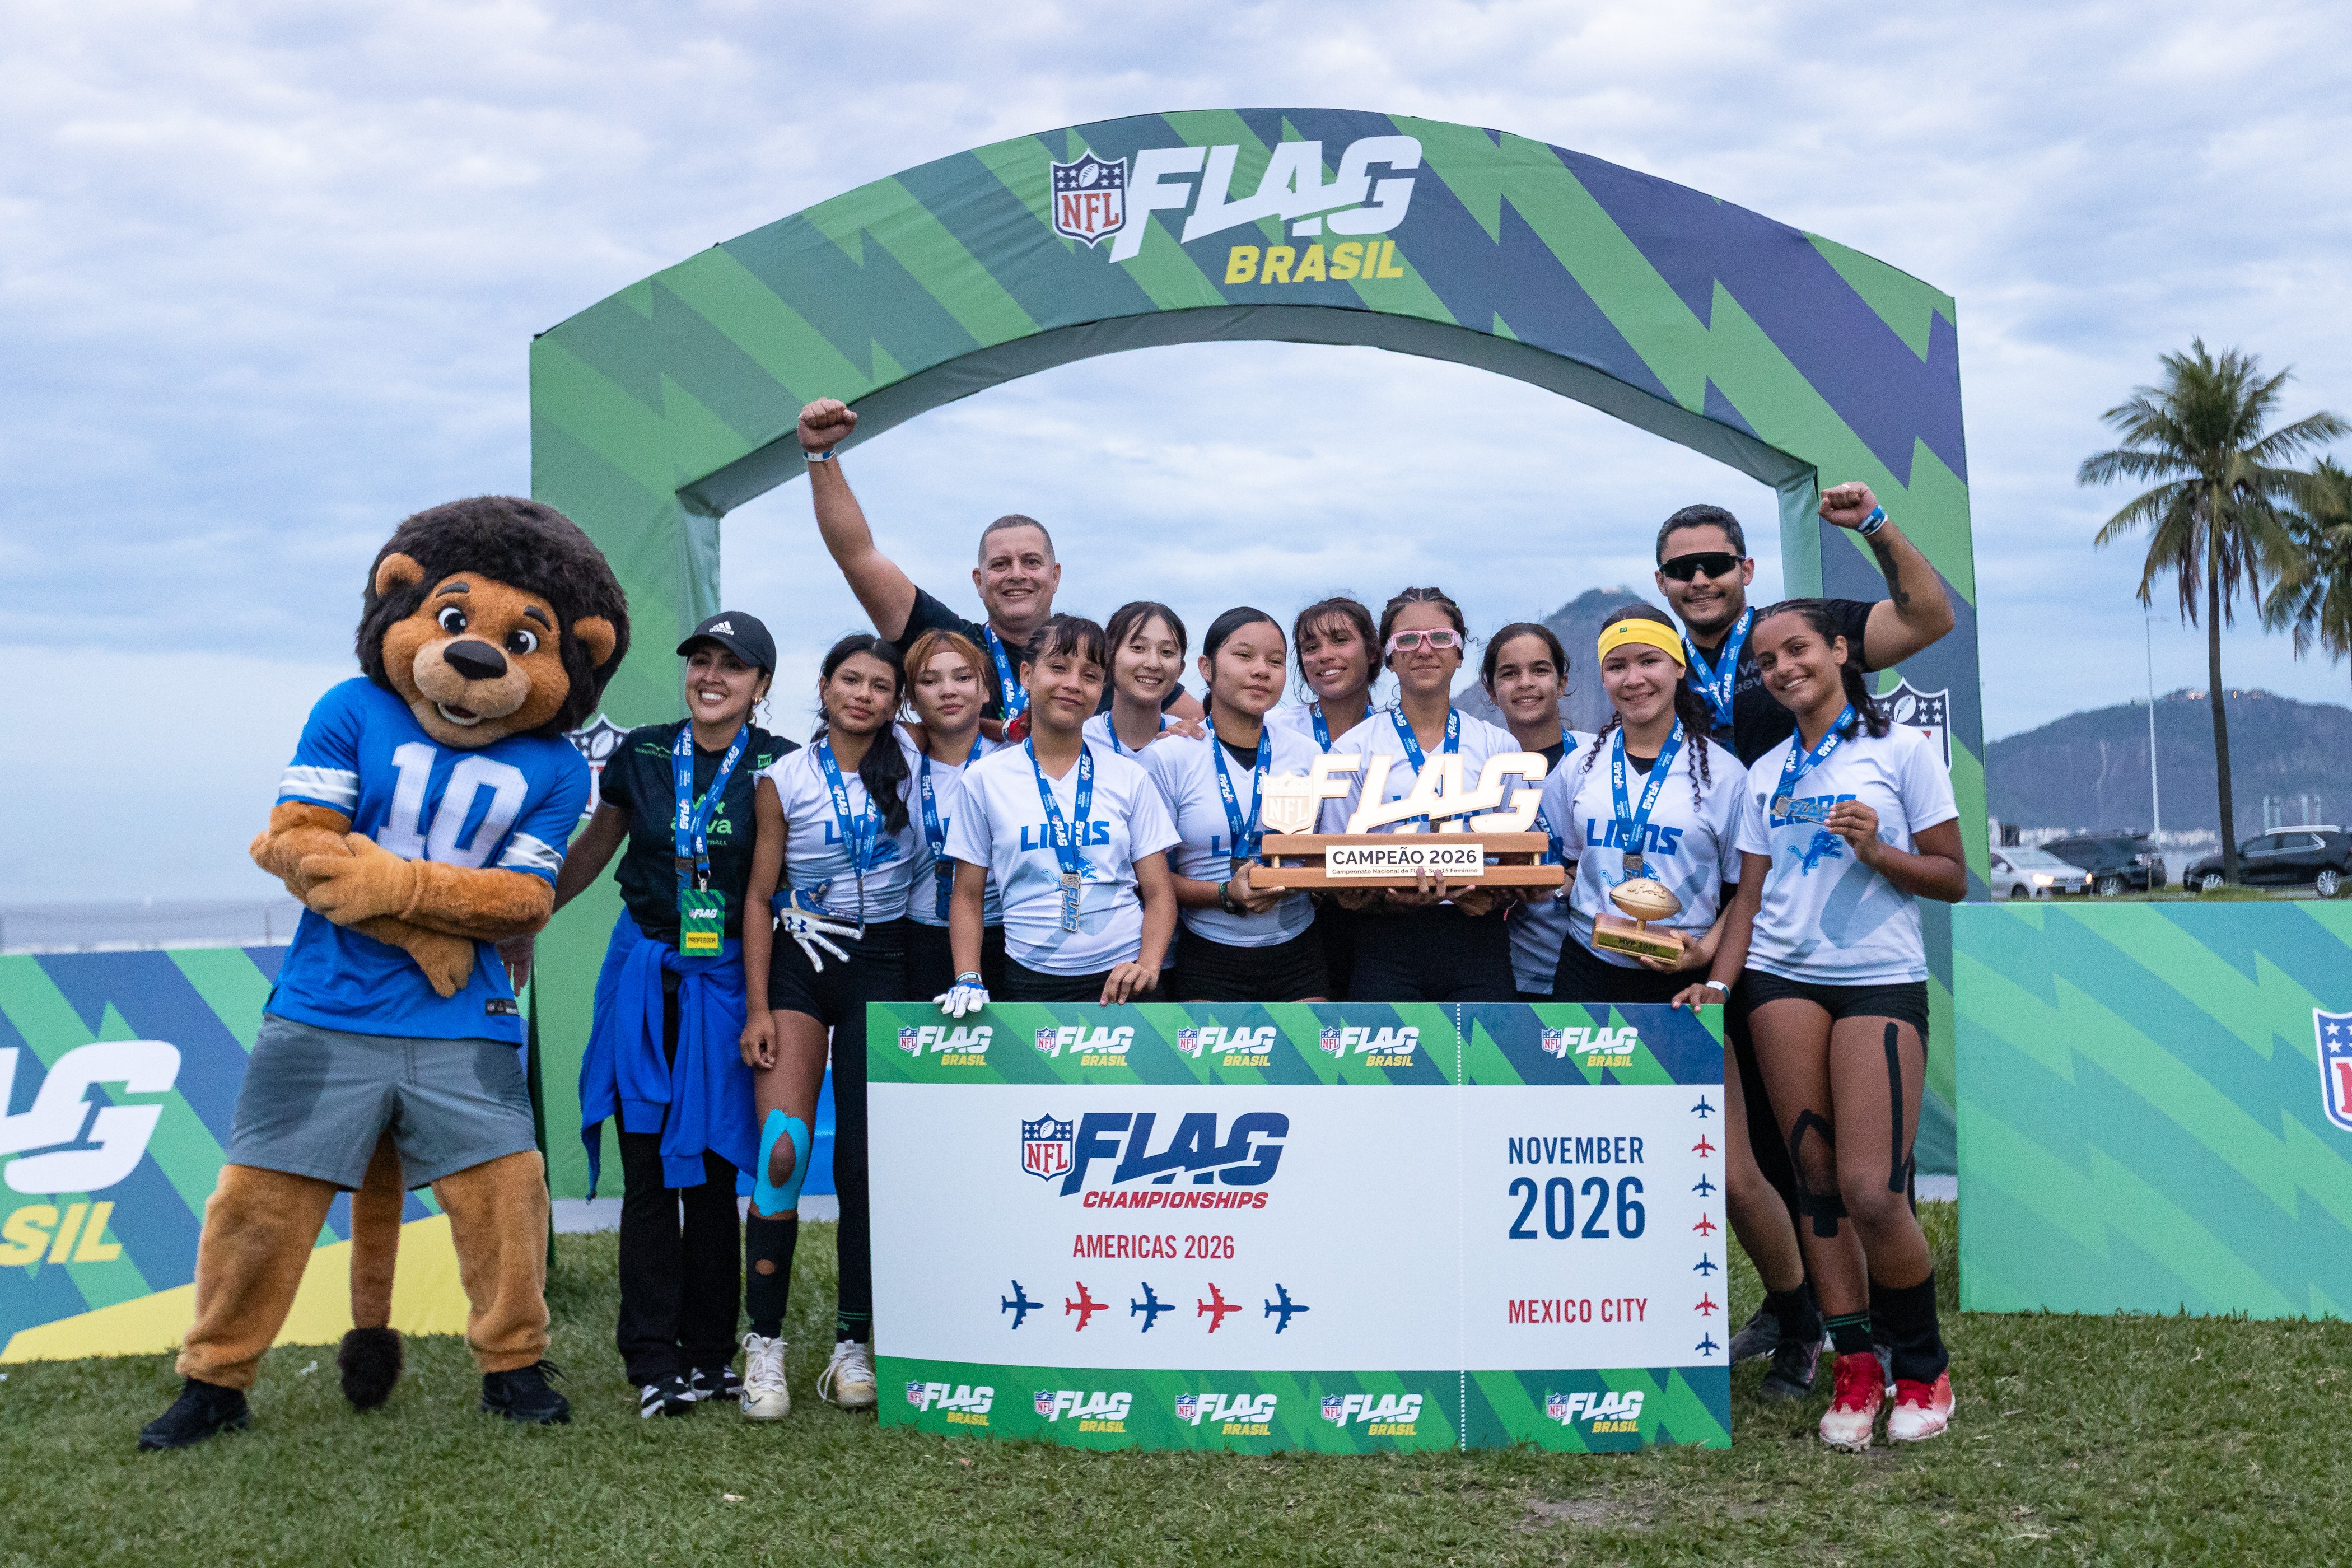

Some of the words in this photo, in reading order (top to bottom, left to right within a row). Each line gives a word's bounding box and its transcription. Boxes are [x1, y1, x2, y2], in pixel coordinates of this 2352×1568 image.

[1061, 192, 1120, 234] NFL
[1109, 136, 1423, 263] FLAG
[1224, 240, 1404, 285] BRASIL
[709, 627, 734, 636] adidas
[377, 741, 528, 869] 10
[1267, 796, 1309, 826] NFL
[1297, 752, 1548, 834] FLAG
[1642, 783, 1659, 810] FLAG
[1052, 820, 1068, 847] FLAG
[1332, 846, 1424, 865] CAMPEÃO
[1429, 850, 1477, 864] 2026
[693, 909, 717, 919] FLAG
[1061, 883, 1080, 932] FLAG
[899, 1037, 917, 1049] NFL
[912, 1026, 993, 1058] FLAG
[1037, 1038, 1056, 1049] NFL
[1049, 1026, 1135, 1058] FLAG
[1179, 1038, 1197, 1050] NFL
[1191, 1026, 1277, 1058] FLAG
[1322, 1038, 1340, 1050] NFL
[1334, 1026, 1420, 1059] FLAG
[1543, 1038, 1561, 1051] NFL
[1556, 1026, 1639, 1060] FLAG
[940, 1054, 987, 1066] BRASIL
[1080, 1054, 1128, 1066] BRASIL
[1222, 1054, 1271, 1067] BRASIL
[1365, 1054, 1415, 1067] BRASIL
[1586, 1054, 1634, 1067] BRASIL
[1026, 1143, 1068, 1175] NFL
[1060, 1112, 1290, 1197] FLAG
[1508, 1137, 1644, 1164] NOVEMBER
[1082, 1191, 1268, 1210] CHAMPIONSHIPS
[1508, 1176, 1646, 1240] 2026
[1072, 1234, 1177, 1259] AMERICAS
[1184, 1235, 1234, 1259] 2026
[1508, 1299, 1592, 1324] MEXICO
[1600, 1298, 1648, 1323] CITY
[907, 1389, 924, 1404] NFL
[919, 1382, 995, 1413] FLAG
[1036, 1401, 1054, 1415] NFL
[1049, 1390, 1133, 1422] FLAG
[1178, 1404, 1196, 1418] NFL
[1191, 1393, 1277, 1426] FLAG
[1324, 1406, 1342, 1419] NFL
[1337, 1393, 1424, 1427] FLAG
[1548, 1404, 1567, 1418] NFL
[1561, 1390, 1645, 1426] FLAG
[946, 1411, 990, 1427] BRASIL
[1079, 1420, 1126, 1433] BRASIL
[1222, 1422, 1271, 1436] BRASIL
[1368, 1423, 1417, 1436] BRASIL
[1591, 1420, 1639, 1434] BRASIL
